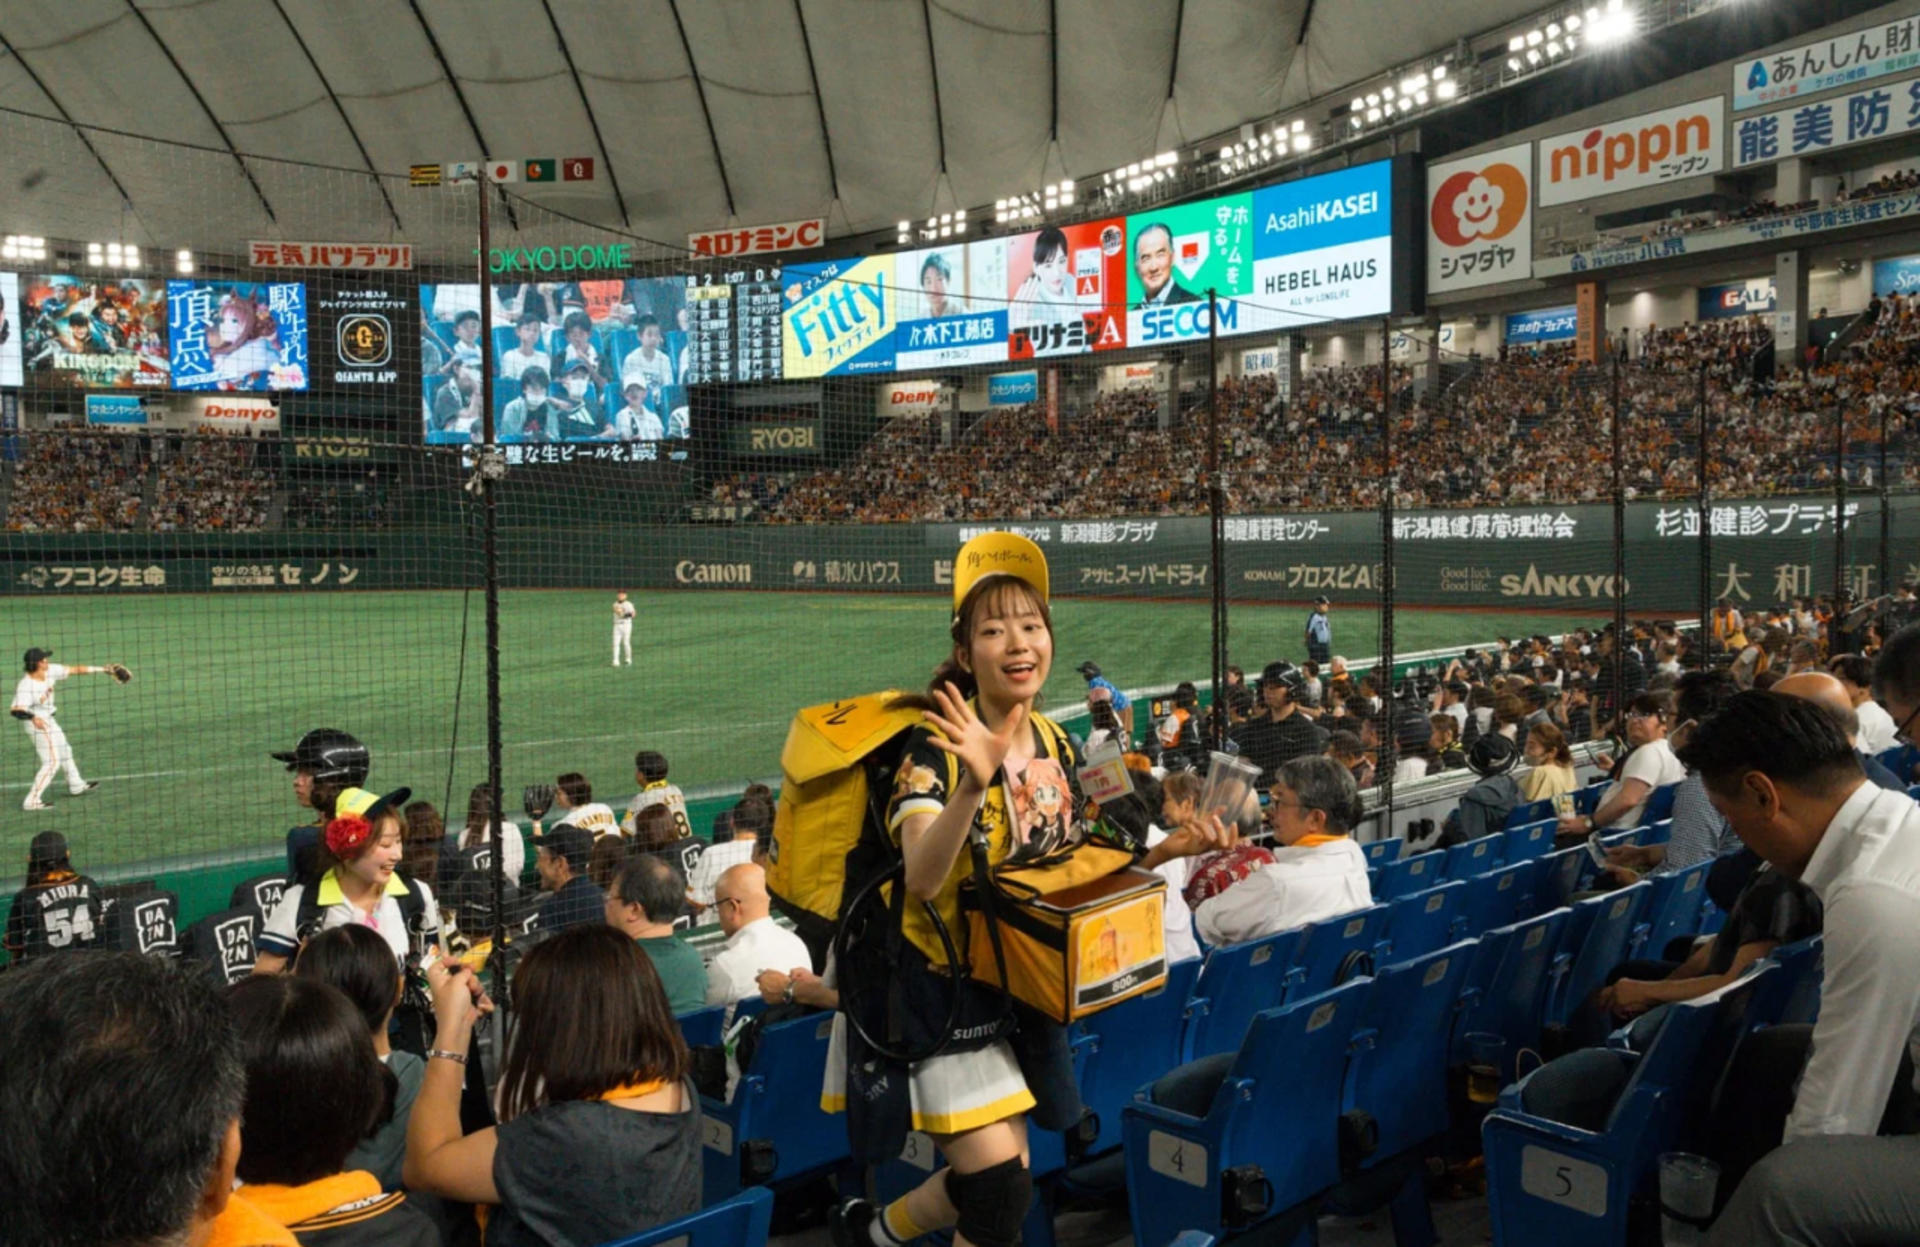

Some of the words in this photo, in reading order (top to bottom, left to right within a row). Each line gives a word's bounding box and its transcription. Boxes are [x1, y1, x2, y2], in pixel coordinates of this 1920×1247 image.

[1772, 20, 1920, 83] あんしん財
[1550, 113, 1710, 184] nippn
[1659, 156, 1710, 178] ニップン
[1265, 191, 1378, 234] AsahiKASEI
[692, 219, 820, 258] オロナミンC
[1215, 205, 1232, 256] 守る。
[252, 243, 410, 268] 元気ハツラツ!
[561, 244, 633, 271] DOME
[1226, 205, 1248, 294] ホームを、
[1440, 243, 1517, 280] シマダヤ
[756, 269, 764, 281] 0
[803, 263, 839, 291] マスクは
[1265, 269, 1322, 300] HEBEL
[1327, 258, 1377, 284] HAUS
[269, 283, 308, 365] 駆け上がれ
[790, 271, 885, 358] Fitty
[1142, 301, 1238, 341] SECOM
[168, 286, 214, 373] 頂点へ
[923, 317, 995, 345] 木下工務店
[53, 352, 141, 370] KINGDOM
[335, 372, 374, 383] GIANTS
[377, 371, 397, 383] APP
[891, 390, 936, 405] Deny
[204, 405, 277, 421] Denyo
[295, 434, 370, 458] RYOBI
[751, 428, 814, 449] RYOBI
[495, 443, 630, 464] 壁な生ビールを。
[1060, 521, 1158, 543] 新潟健診プラザ
[1217, 518, 1330, 542] 岡健康管理センター
[1656, 503, 1859, 537] 杉並健診プラザ
[51, 565, 166, 587] フコク生命
[212, 565, 275, 577] 守りの名手
[279, 563, 360, 586] セノン
[675, 560, 752, 584] Canon
[824, 560, 901, 584] 積水ハウス
[1243, 569, 1287, 583] KONAMI
[1287, 563, 1372, 590] プロスピA
[1441, 566, 1469, 579] Good
[1500, 563, 1631, 597] SANKYO
[1441, 580, 1469, 593] Good
[37, 884, 89, 908] MIURA
[44, 904, 97, 948] 54
[145, 907, 166, 925] DA
[227, 925, 249, 946] DA
[227, 944, 248, 964] ZN
[710, 1125, 721, 1145] 2
[907, 1136, 918, 1159] 3
[1170, 1141, 1186, 1173] 4
[1554, 1166, 1573, 1197] 5
